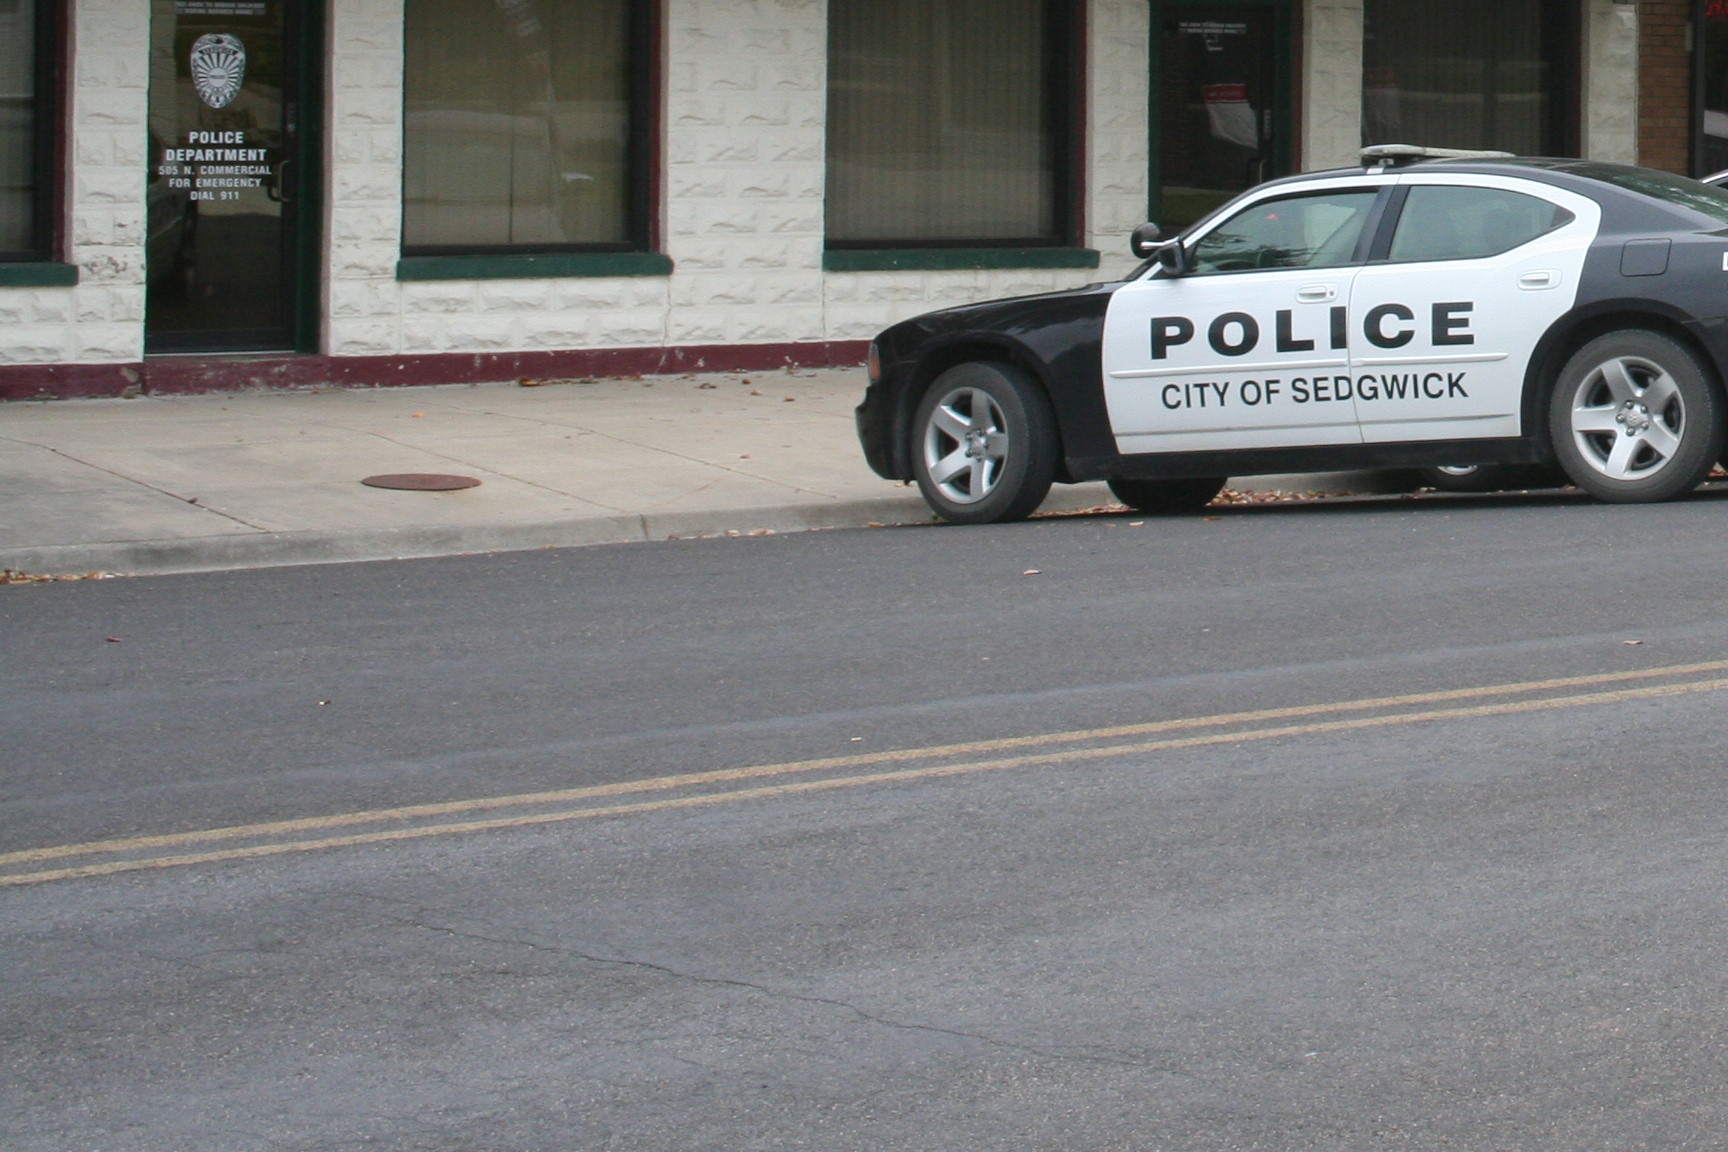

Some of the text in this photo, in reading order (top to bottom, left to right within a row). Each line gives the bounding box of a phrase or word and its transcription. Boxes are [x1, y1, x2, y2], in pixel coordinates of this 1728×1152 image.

[189, 131, 244, 144] POLICE
[166, 149, 267, 161] DEPARTMENT
[158, 165, 273, 175] 505 N. COMMERCIAL
[169, 178, 262, 188] FOR EMERGENCY
[190, 191, 240, 201] DIAL 911
[1150, 301, 1475, 360] POLICE
[1161, 372, 1469, 409] CITY OF SEDGWICK
